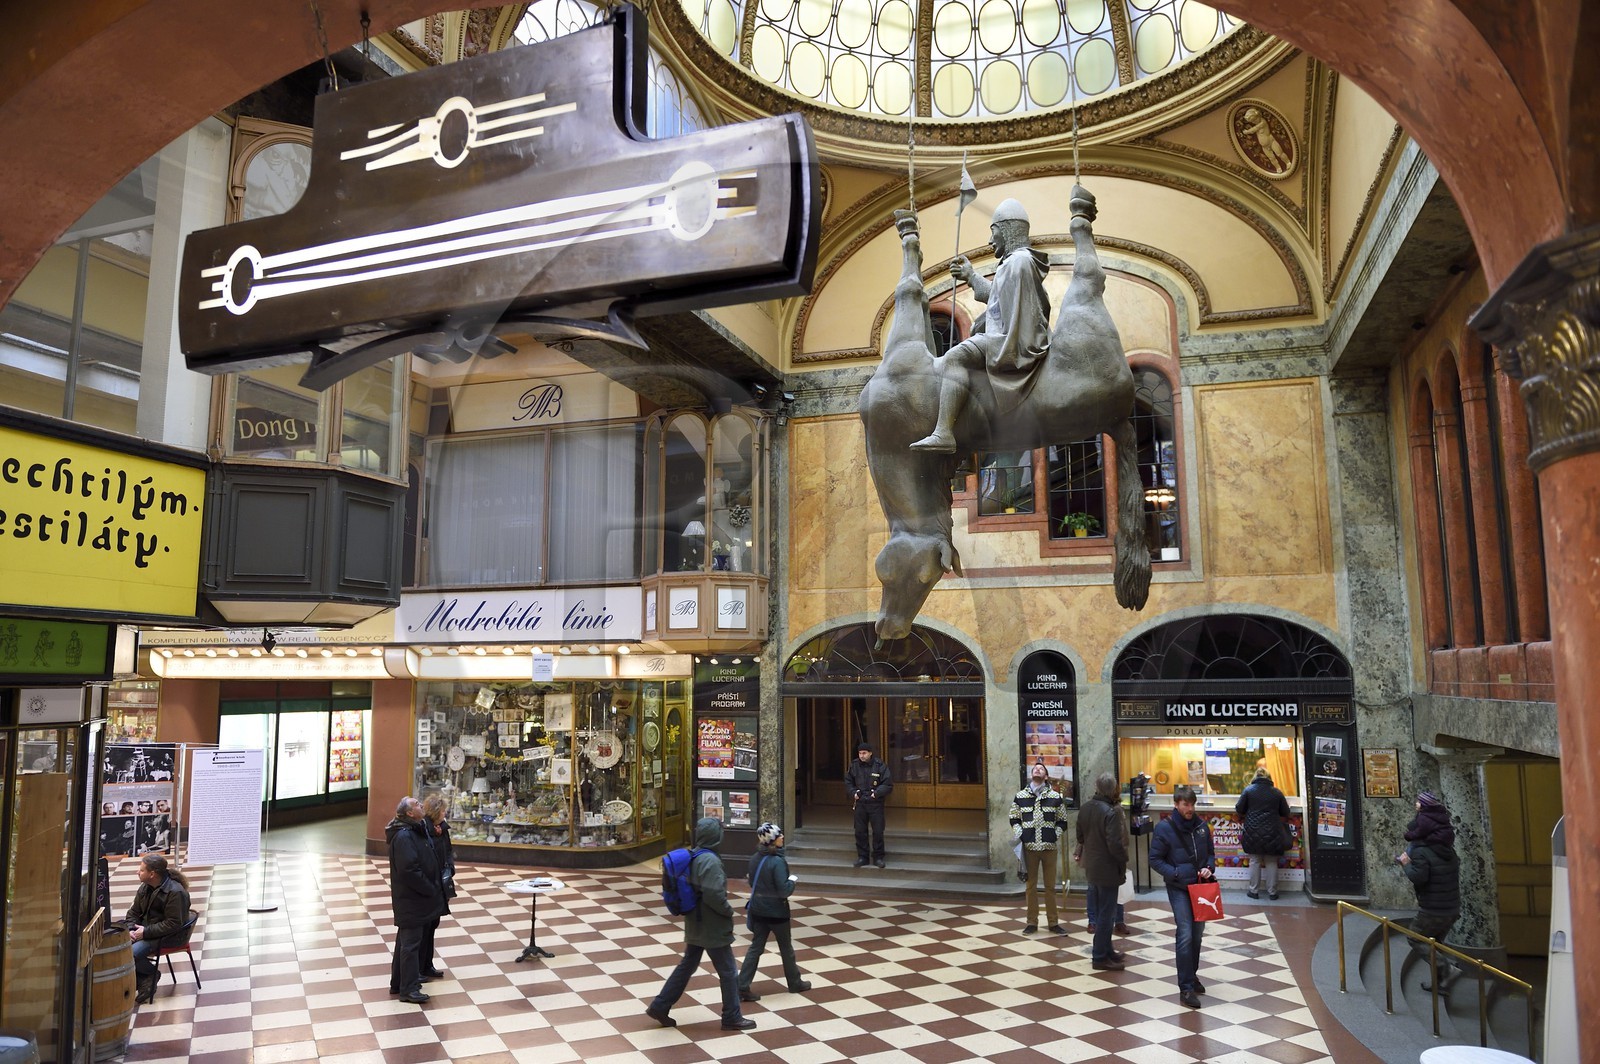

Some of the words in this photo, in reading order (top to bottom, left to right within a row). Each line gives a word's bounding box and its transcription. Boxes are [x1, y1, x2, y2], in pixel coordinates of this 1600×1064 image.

[238, 418, 298, 440] Dong
[408, 598, 543, 633] Modrobílá
[562, 600, 614, 630] linie
[718, 692, 739, 700] PŘÍŠTÍ
[1032, 700, 1063, 709] DNEŠNÍ
[1166, 703, 1206, 717] KINO
[1211, 703, 1298, 717] LUCERNA
[1028, 709, 1068, 717] PROGRAM
